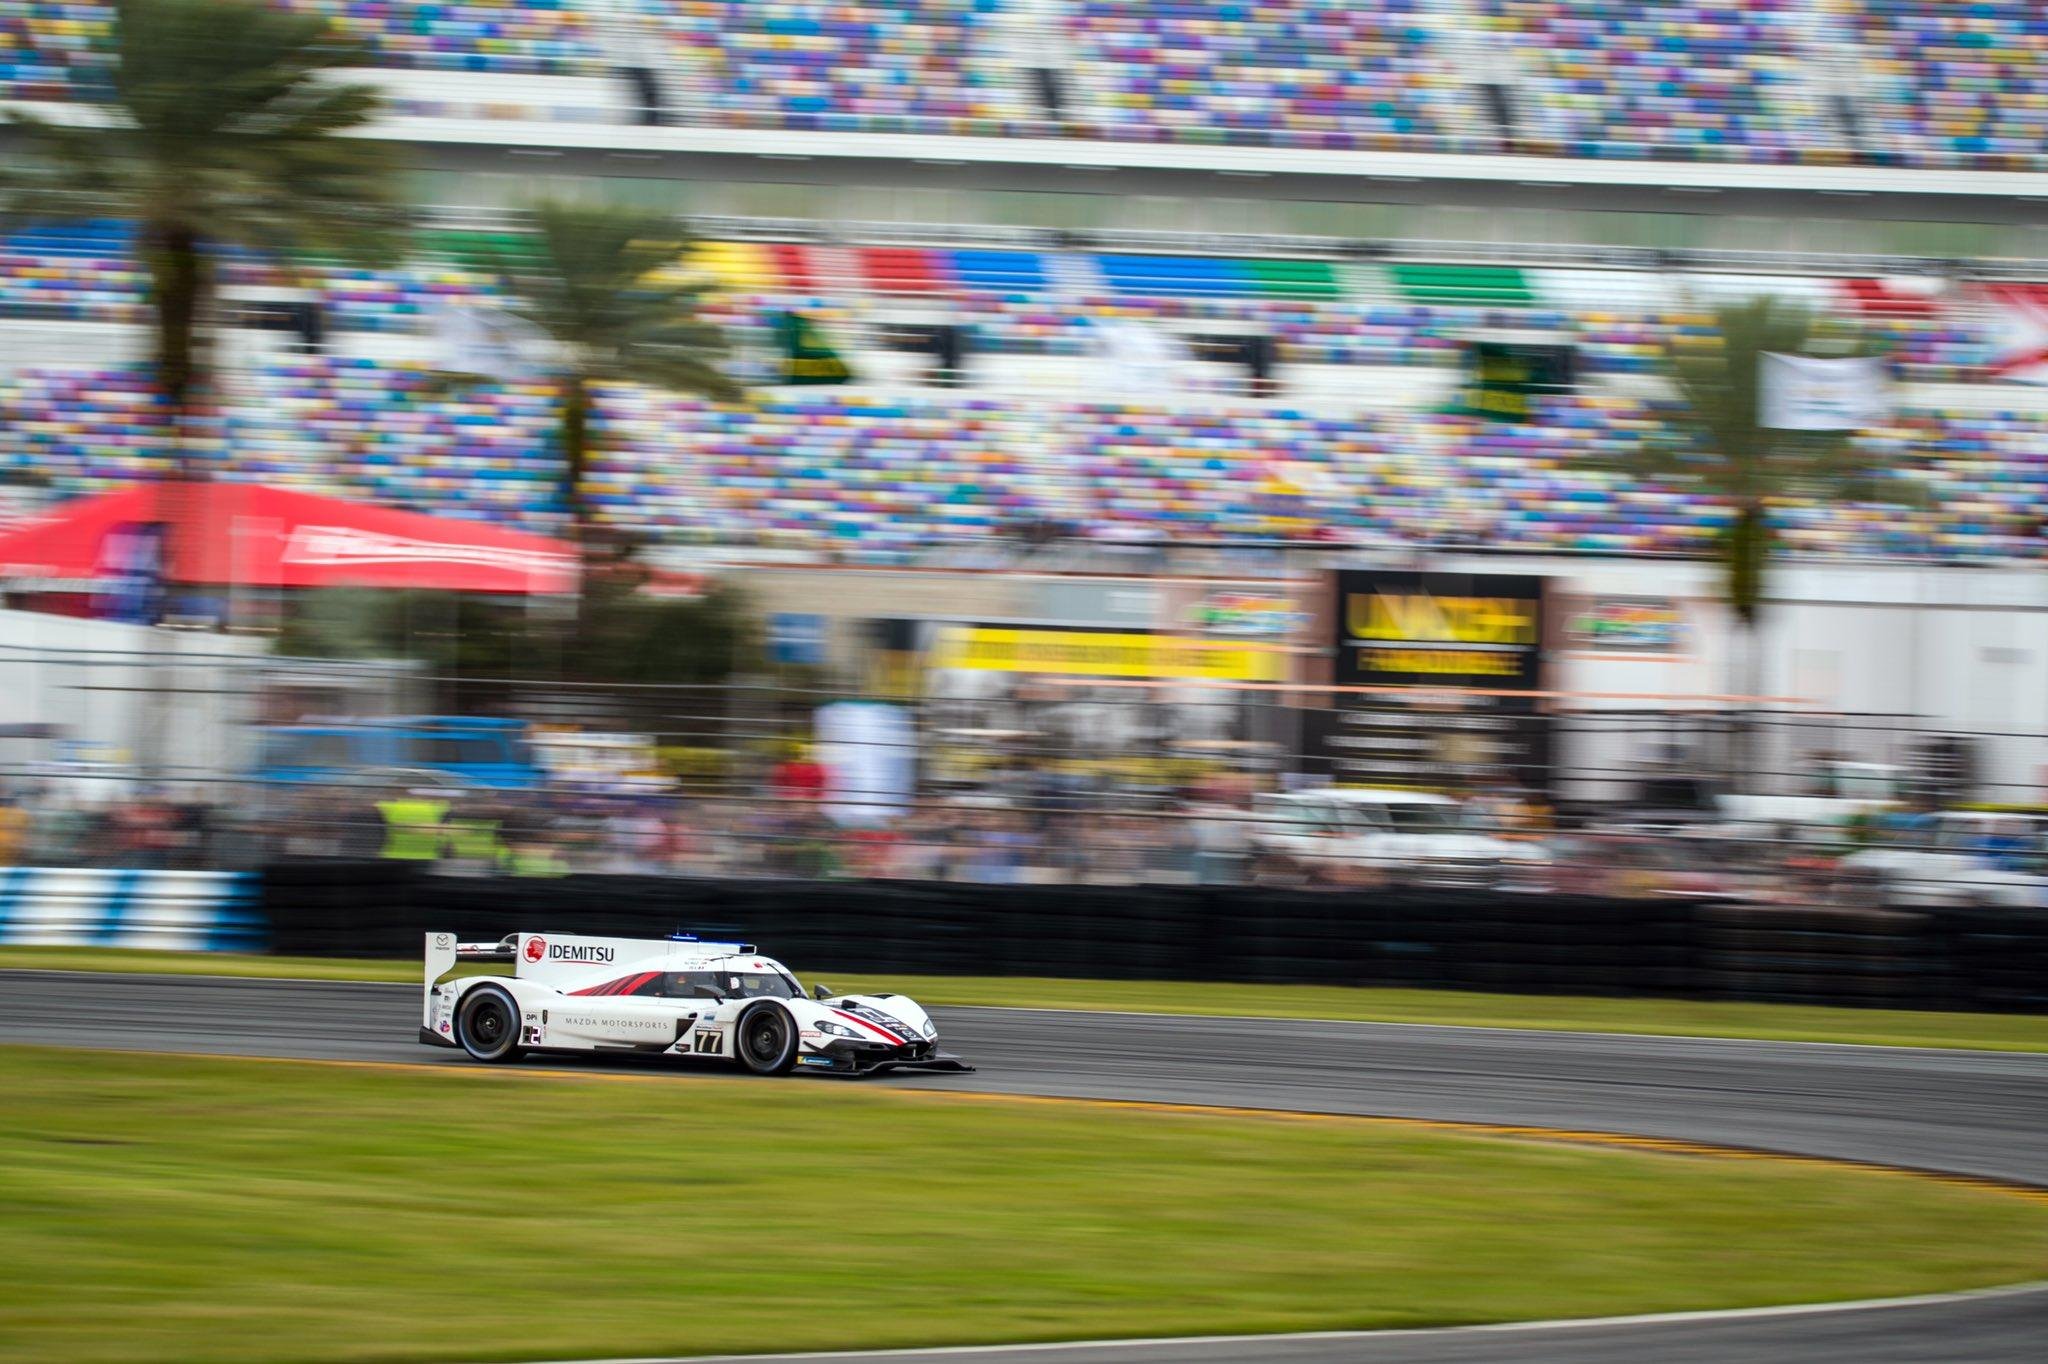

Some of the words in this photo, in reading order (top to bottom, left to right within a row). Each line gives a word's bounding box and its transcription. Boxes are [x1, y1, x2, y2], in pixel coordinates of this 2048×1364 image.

[549, 944, 615, 962] IDEMITSU
[526, 1013, 538, 1021] DPi
[565, 1017, 598, 1026] MAZDA
[601, 1019, 668, 1030] MOTORSPORTS
[696, 1030, 721, 1053] 77
